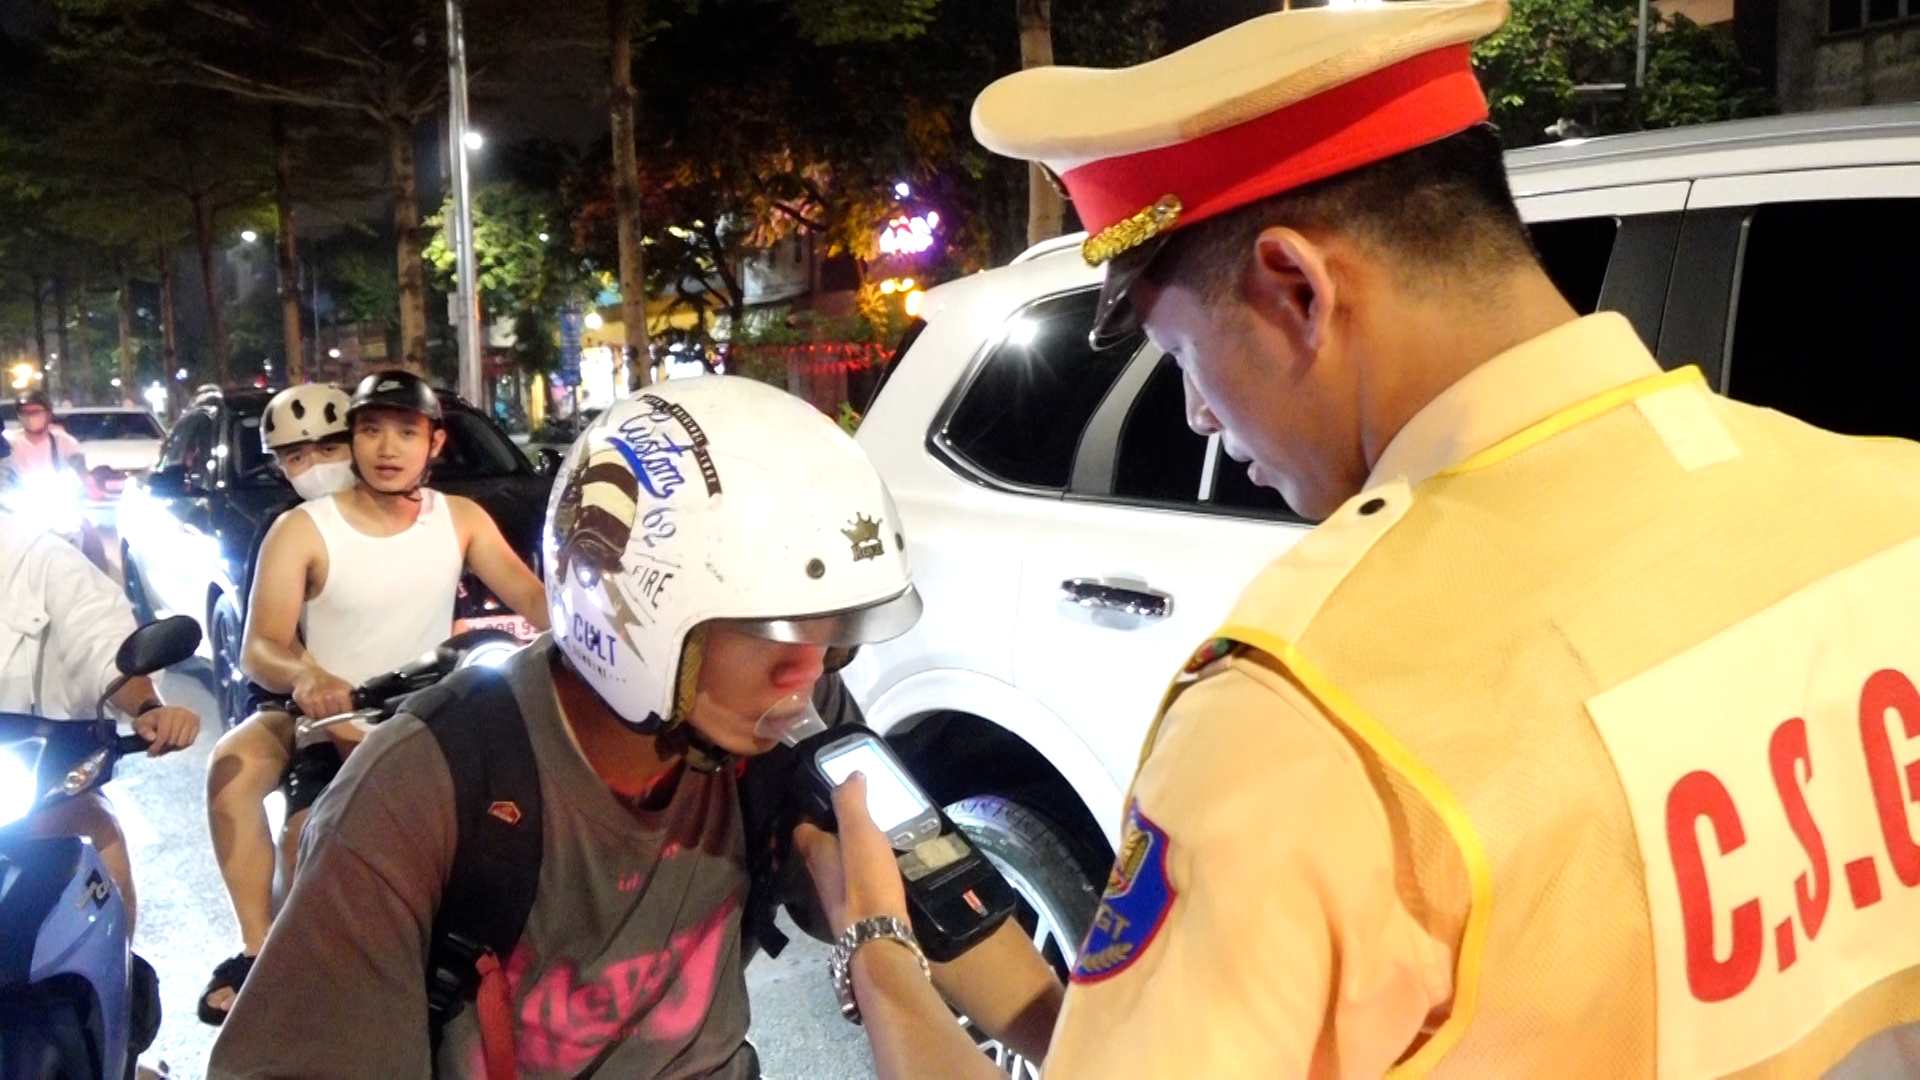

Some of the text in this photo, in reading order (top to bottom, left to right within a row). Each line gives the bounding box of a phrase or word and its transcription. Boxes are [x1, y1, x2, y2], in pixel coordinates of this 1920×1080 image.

[642, 507, 677, 547] 62
[632, 565, 674, 609] FIRE
[573, 612, 617, 667] CULT
